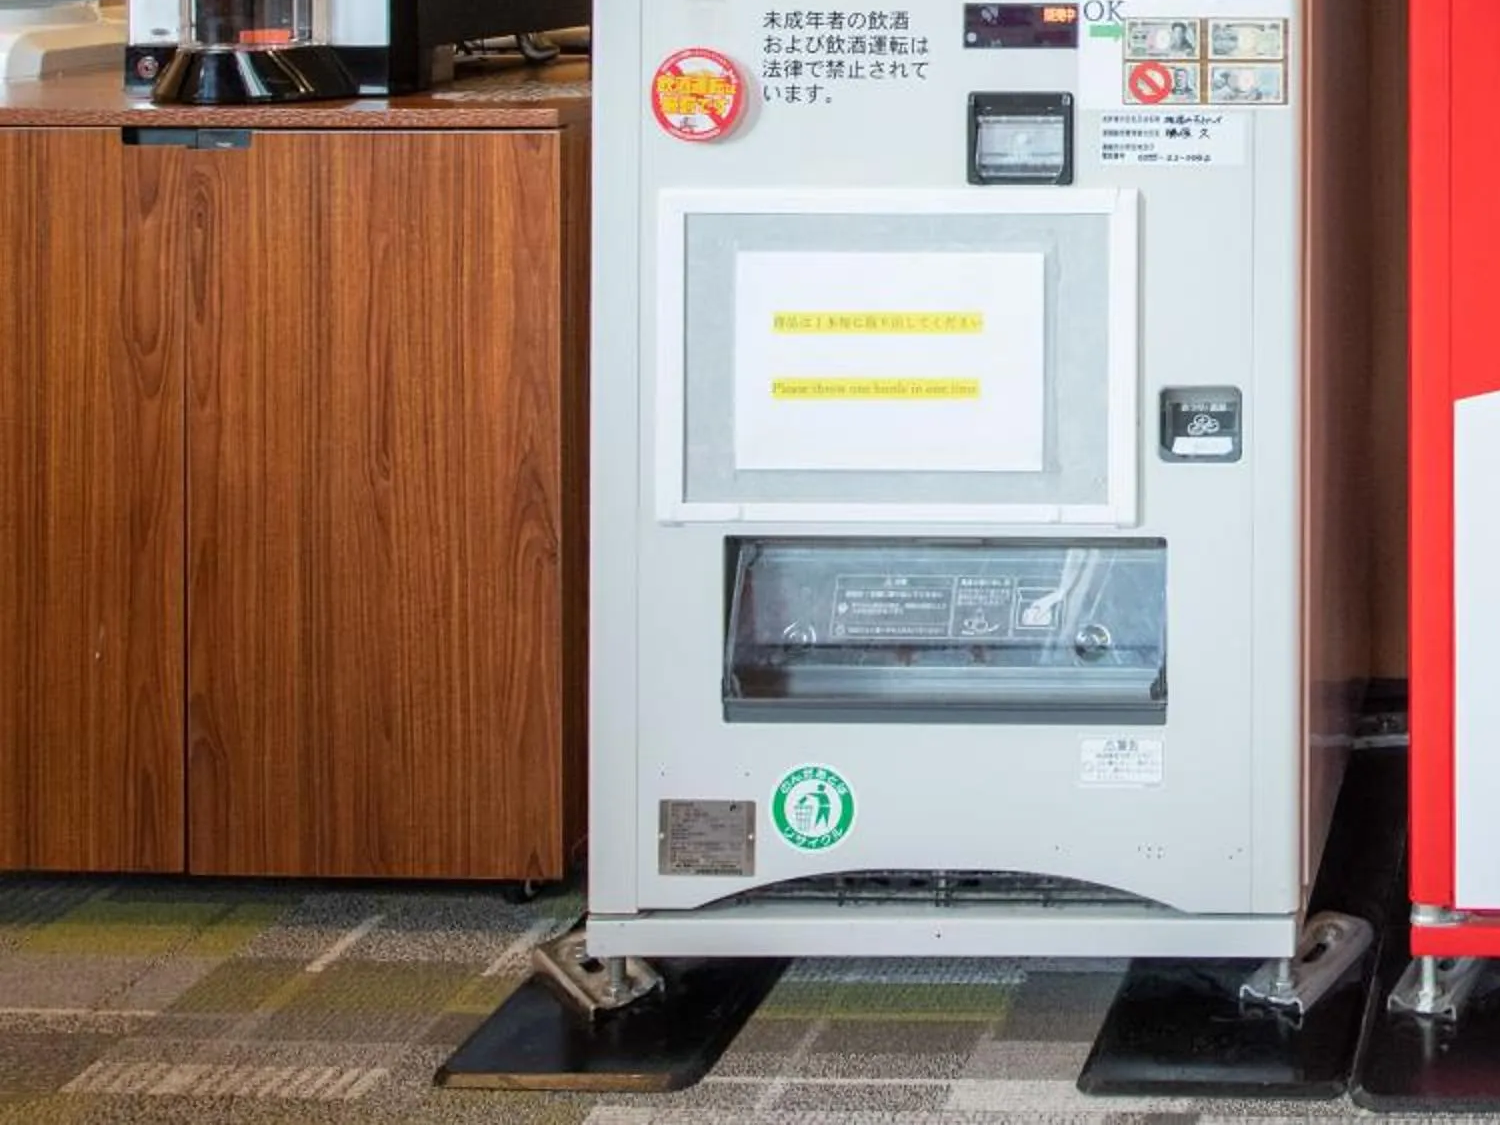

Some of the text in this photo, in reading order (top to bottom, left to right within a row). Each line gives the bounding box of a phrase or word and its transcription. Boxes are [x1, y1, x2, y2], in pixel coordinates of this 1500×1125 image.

[762, 10, 910, 30] 未成年者の飲酒
[1083, 0, 1125, 22] OK
[763, 35, 929, 56] および飲酒運転は
[762, 59, 930, 80] 法律で禁止されて
[763, 84, 833, 104] います。
